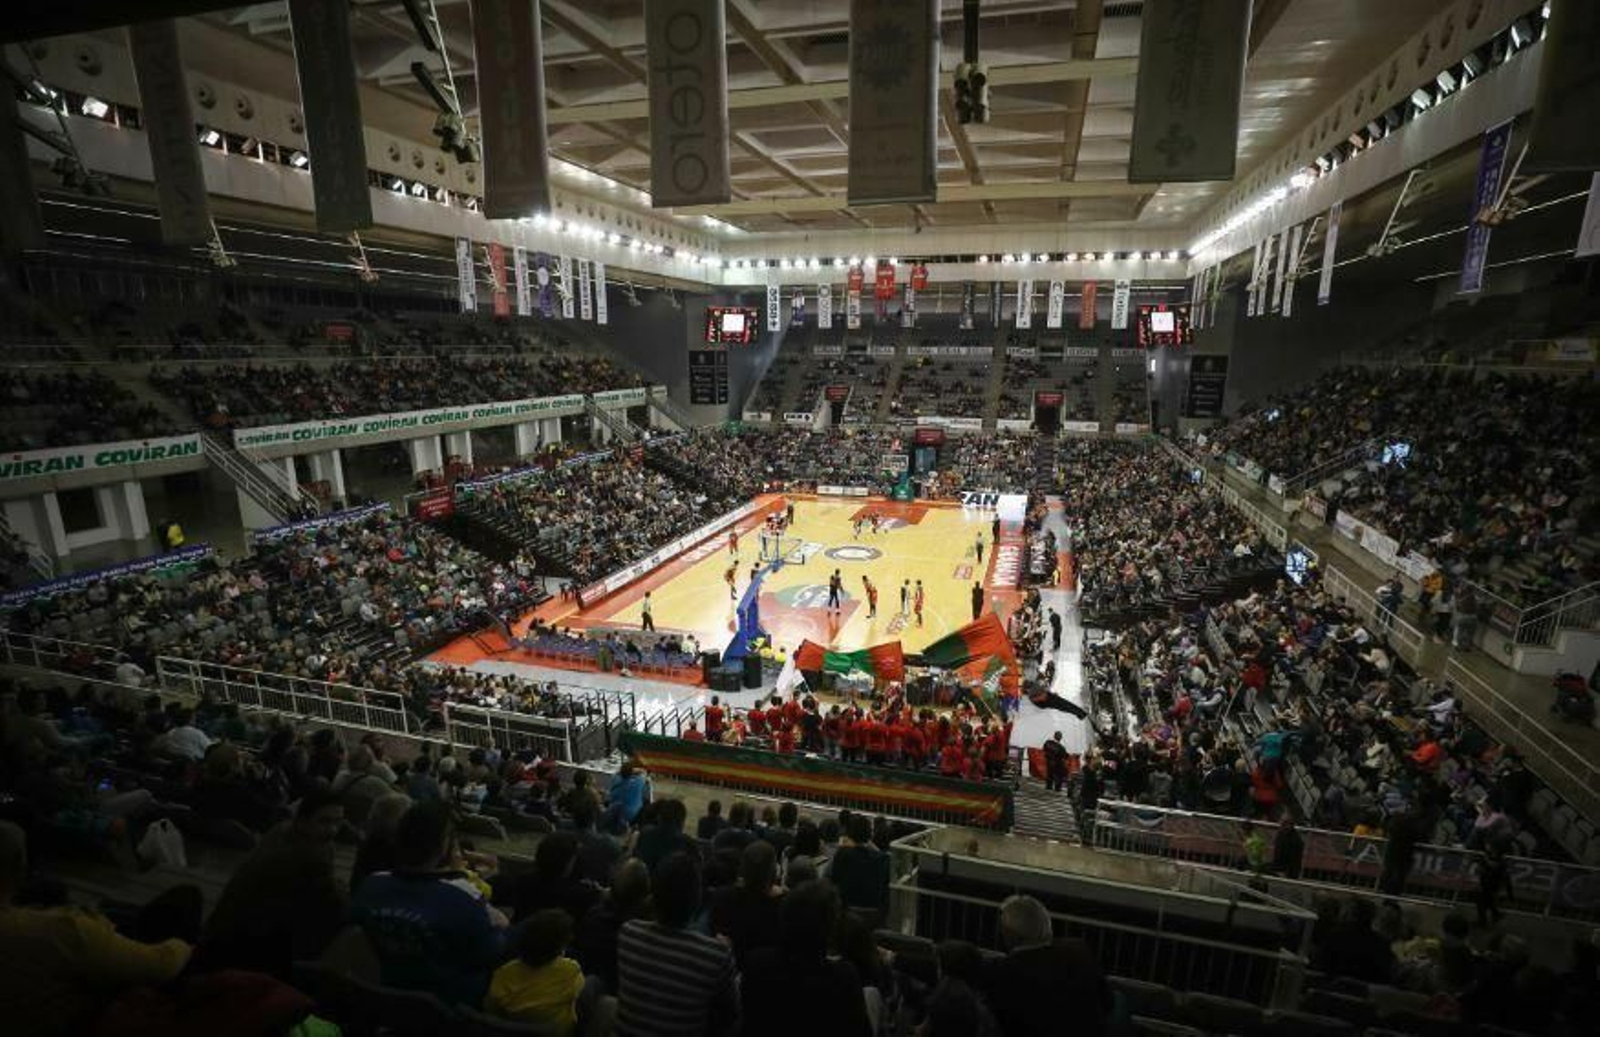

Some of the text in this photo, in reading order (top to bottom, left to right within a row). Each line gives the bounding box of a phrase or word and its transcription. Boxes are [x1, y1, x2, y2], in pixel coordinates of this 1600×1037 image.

[292, 421, 357, 442] COVIRAN
[363, 415, 417, 433] COVIRAN
[422, 409, 468, 425] COVIRAN
[95, 441, 199, 467] COVIRAN
